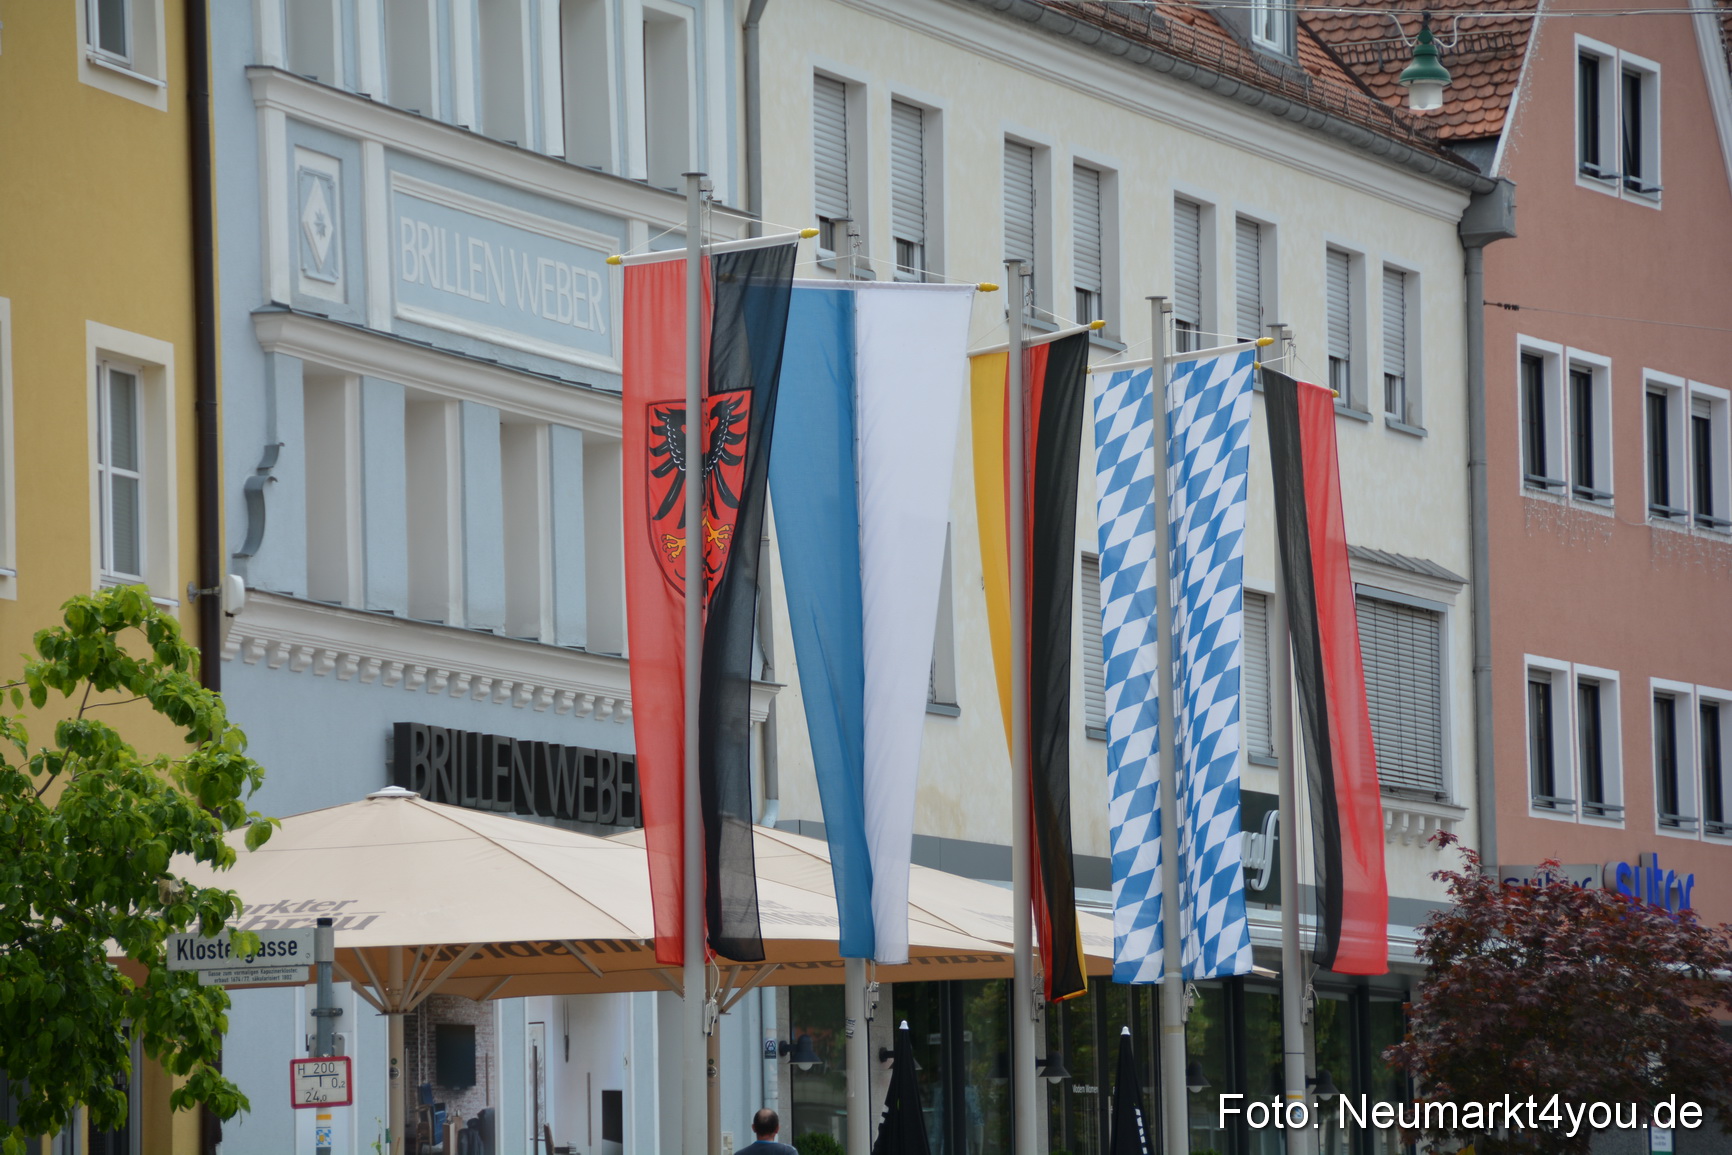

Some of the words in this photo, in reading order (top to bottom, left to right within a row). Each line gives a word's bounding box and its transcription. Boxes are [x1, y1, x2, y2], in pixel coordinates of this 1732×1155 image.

[401, 216, 506, 308] BRILLEN
[509, 248, 606, 335] WEBER
[404, 722, 535, 815] BRILLEN
[176, 938, 298, 964] Klosteasse
[298, 1063, 306, 1075] H
[313, 1062, 335, 1074] 200
